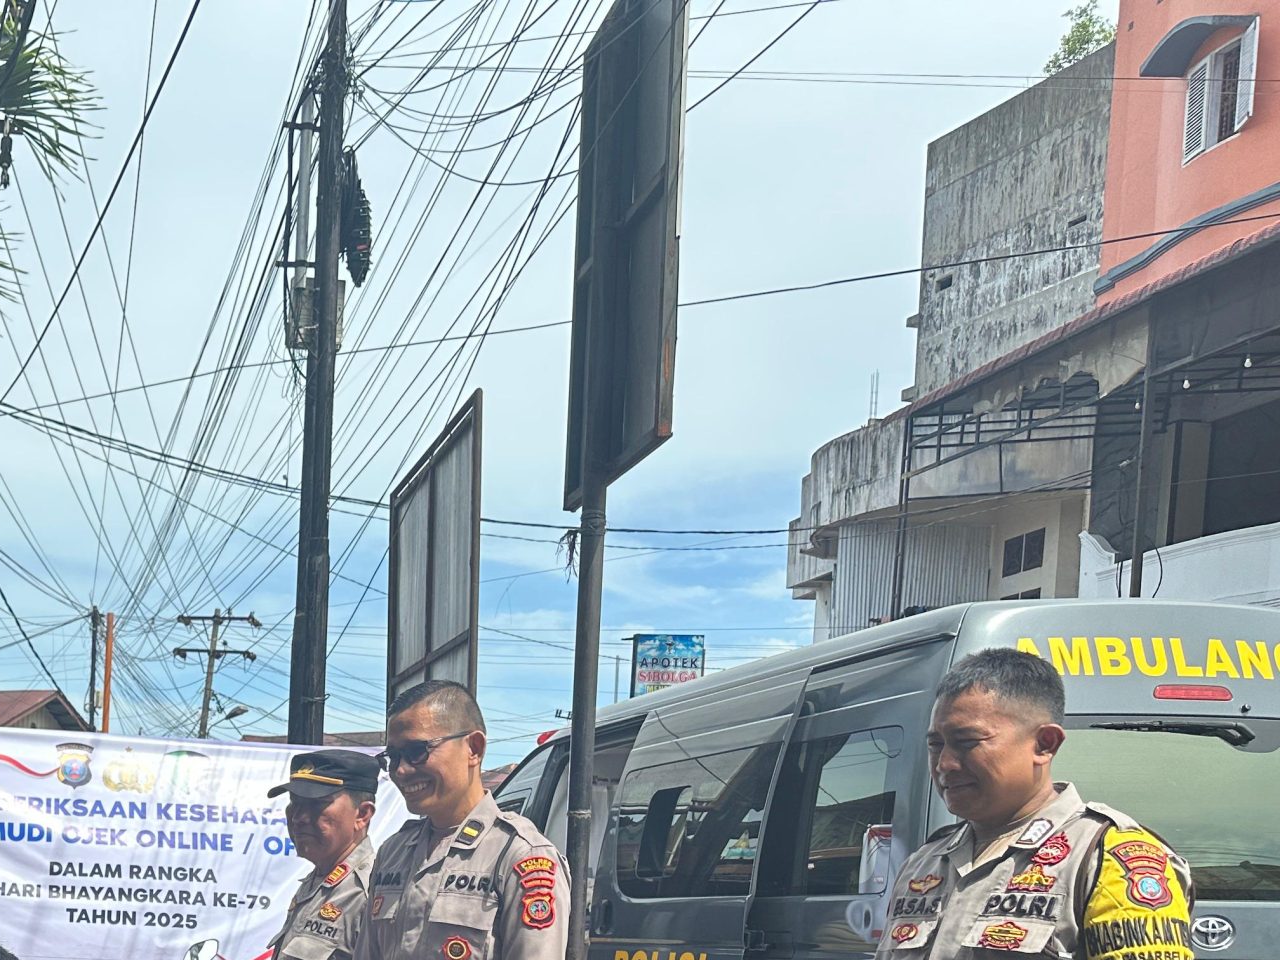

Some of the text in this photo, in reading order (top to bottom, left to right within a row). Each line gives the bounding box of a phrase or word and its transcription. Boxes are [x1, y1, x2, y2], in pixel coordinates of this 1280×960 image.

[640, 657, 699, 668] APOTEK
[1016, 636, 1280, 680] MBULAN
[638, 670, 697, 683] SIBOLGA
[62, 826, 128, 847] OJEK
[136, 830, 233, 852] ONLINE
[242, 833, 254, 855] /
[49, 861, 218, 884] DALAM RANGKA
[48, 885, 207, 907] BHAYANGKARA
[213, 892, 271, 911] KE-79
[983, 894, 1059, 915] POLRI
[66, 908, 198, 929] TAHUN 2025
[303, 920, 338, 939] POLRI
